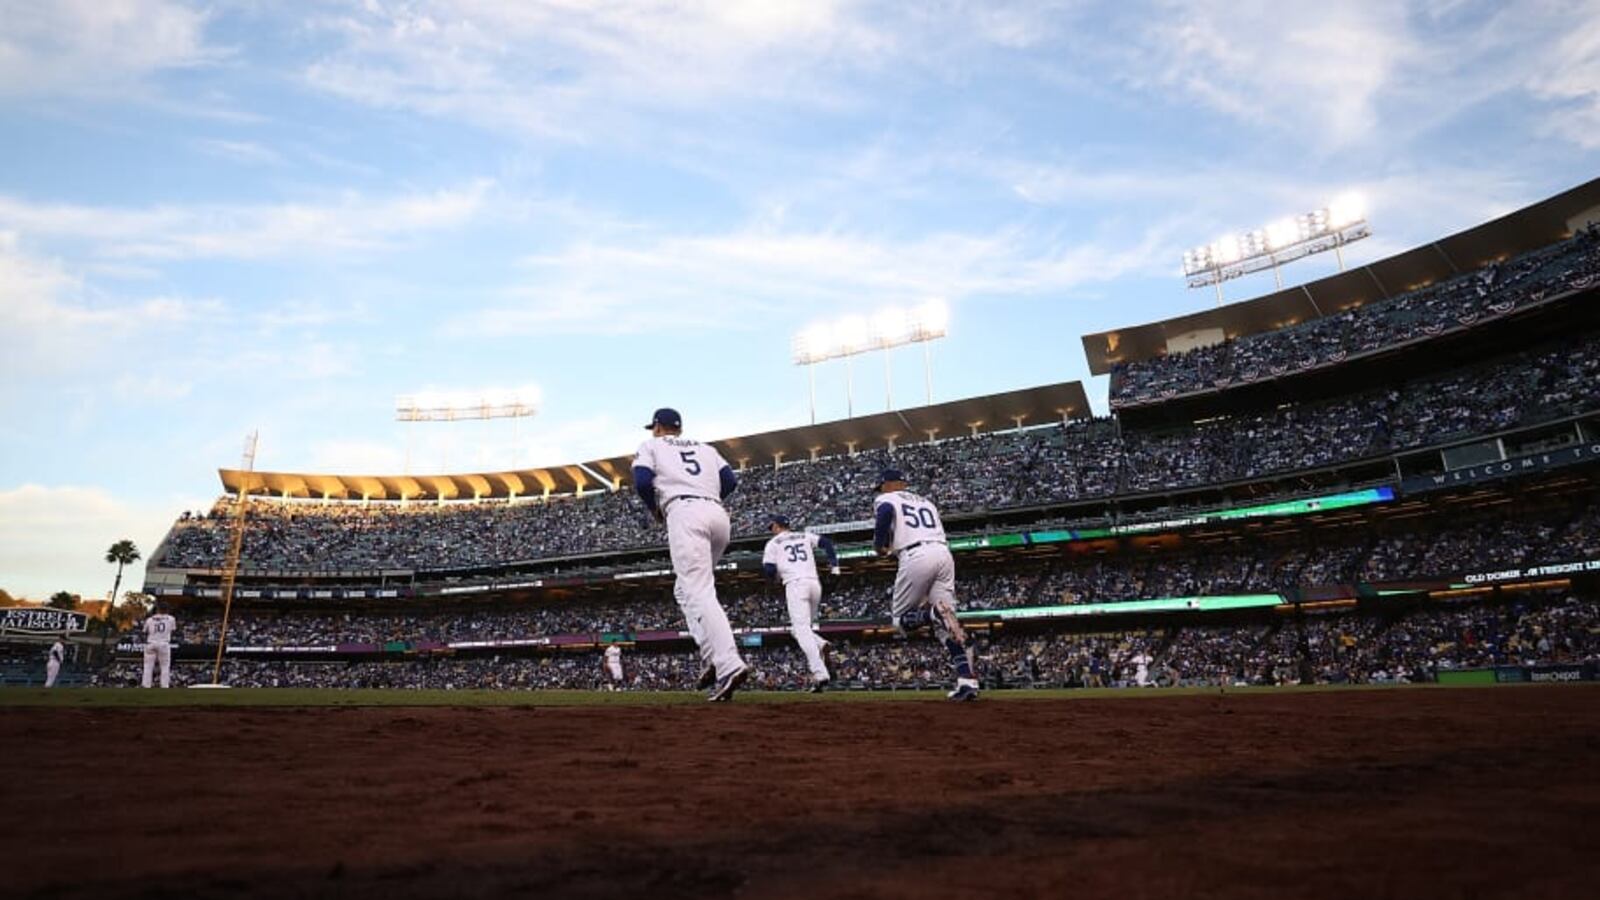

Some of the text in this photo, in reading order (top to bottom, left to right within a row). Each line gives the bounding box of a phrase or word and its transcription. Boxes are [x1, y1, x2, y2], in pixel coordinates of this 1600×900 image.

[679, 450, 702, 476] 5
[1433, 444, 1600, 485] WELCOME TO
[901, 503, 937, 529] 50
[784, 543, 808, 563] 35
